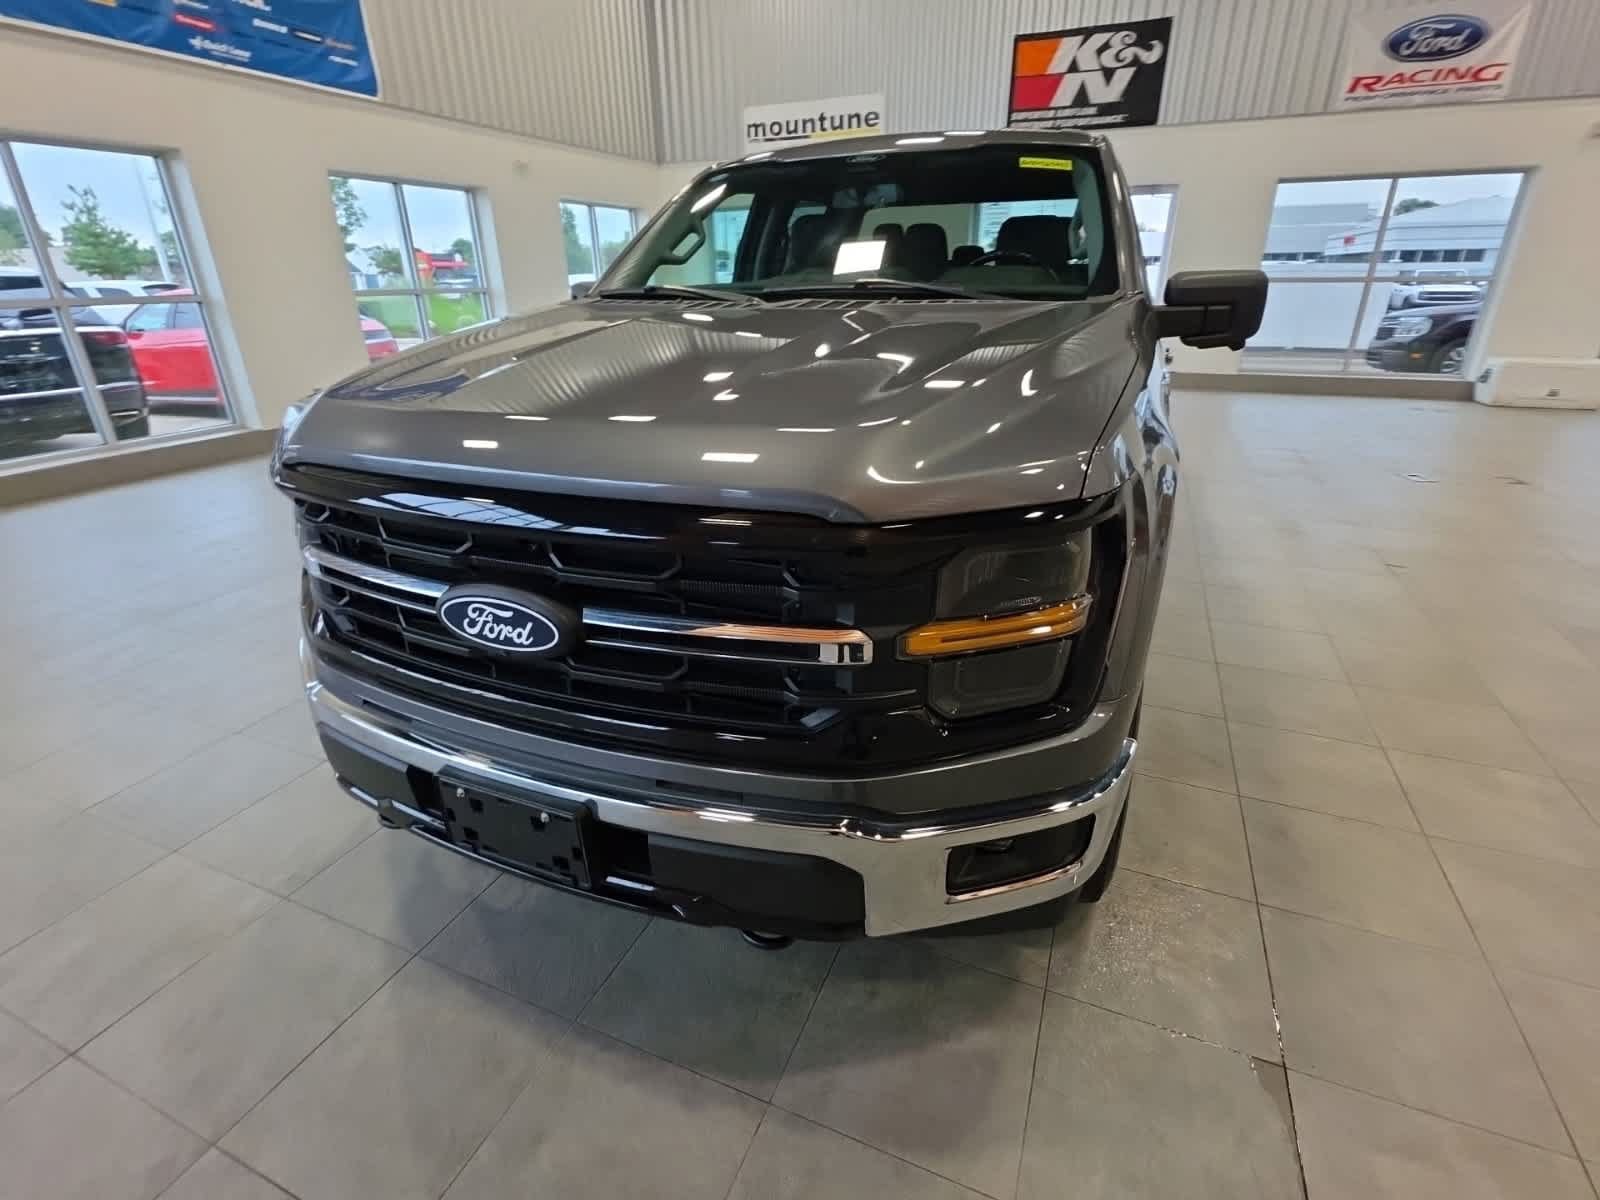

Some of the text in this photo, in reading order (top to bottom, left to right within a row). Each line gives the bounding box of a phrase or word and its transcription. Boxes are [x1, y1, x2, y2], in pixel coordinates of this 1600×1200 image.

[1399, 23, 1473, 56] Ford
[1346, 62, 1511, 94] RACING
[746, 110, 880, 139] mountune
[463, 602, 534, 646] Ford
